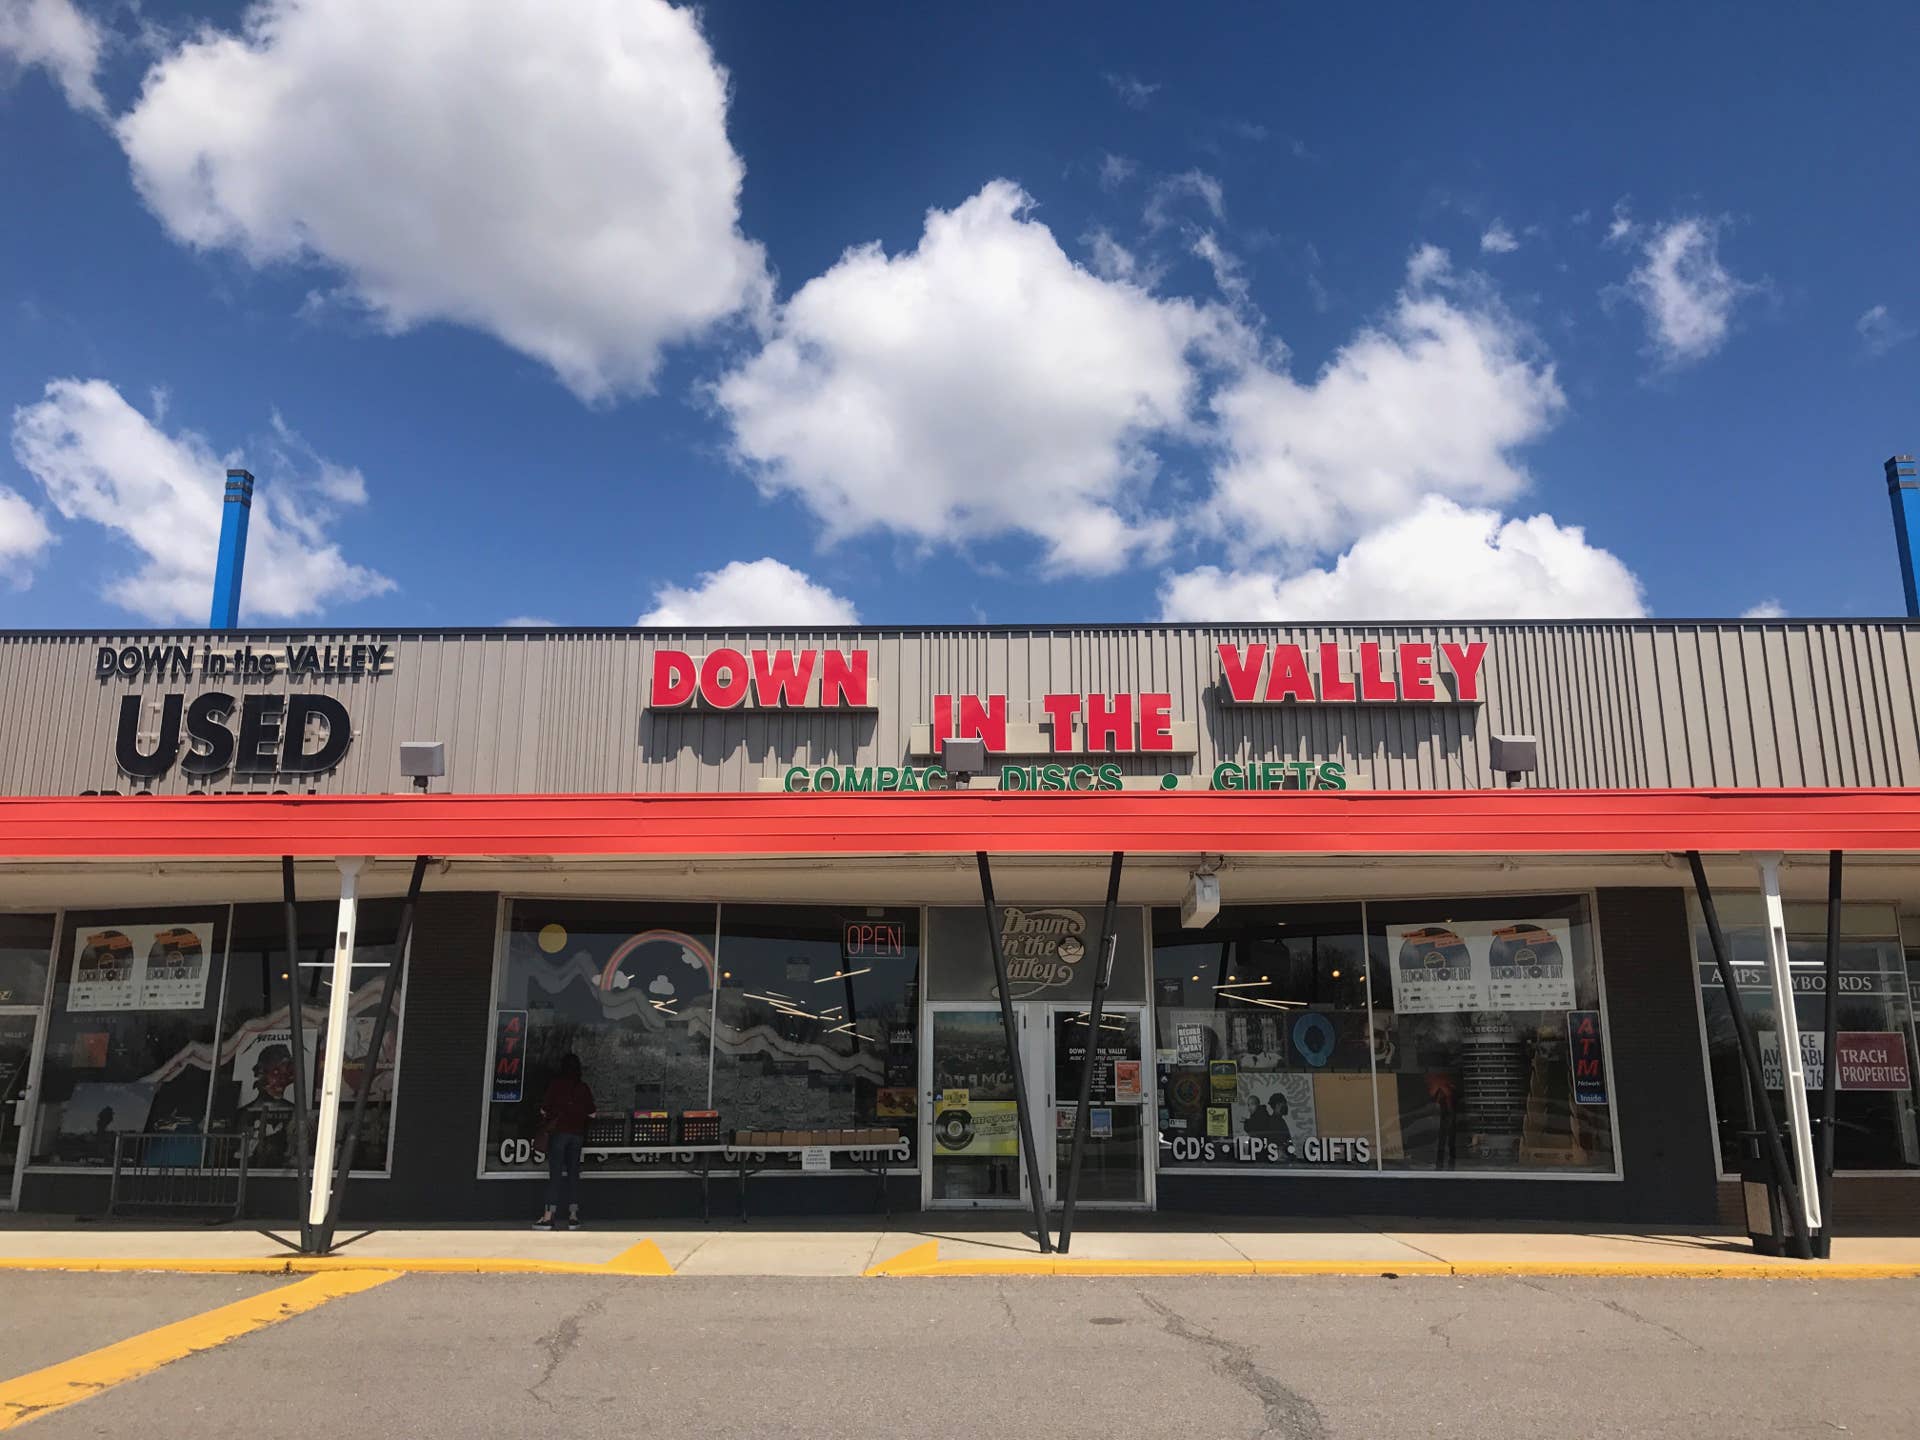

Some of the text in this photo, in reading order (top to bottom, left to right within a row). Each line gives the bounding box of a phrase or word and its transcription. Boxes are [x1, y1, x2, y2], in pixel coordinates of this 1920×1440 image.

[96, 644, 388, 675] DOWN in the VALLEY
[651, 642, 1489, 753] DOWN IN THE VALLEY
[114, 691, 351, 777] USED
[784, 761, 1347, 792] COMPAC DISCS GIFTS
[1000, 907, 1086, 934] Down
[847, 925, 901, 955] OPEN
[1001, 934, 1057, 956] in the
[1459, 967, 1472, 981] DAY
[1550, 965, 1563, 979] DAY
[1792, 976, 1873, 991] YBORDS
[496, 1016, 520, 1074] ATM
[1108, 1047, 1127, 1055] VALLEY
[1576, 1017, 1600, 1077] ATM
[1841, 1049, 1888, 1064] TRACH
[1842, 1066, 1906, 1083] PROPERTIES
[1580, 1094, 1602, 1103] Inside
[1173, 1136, 1371, 1163] CD's LP's GIFTS
